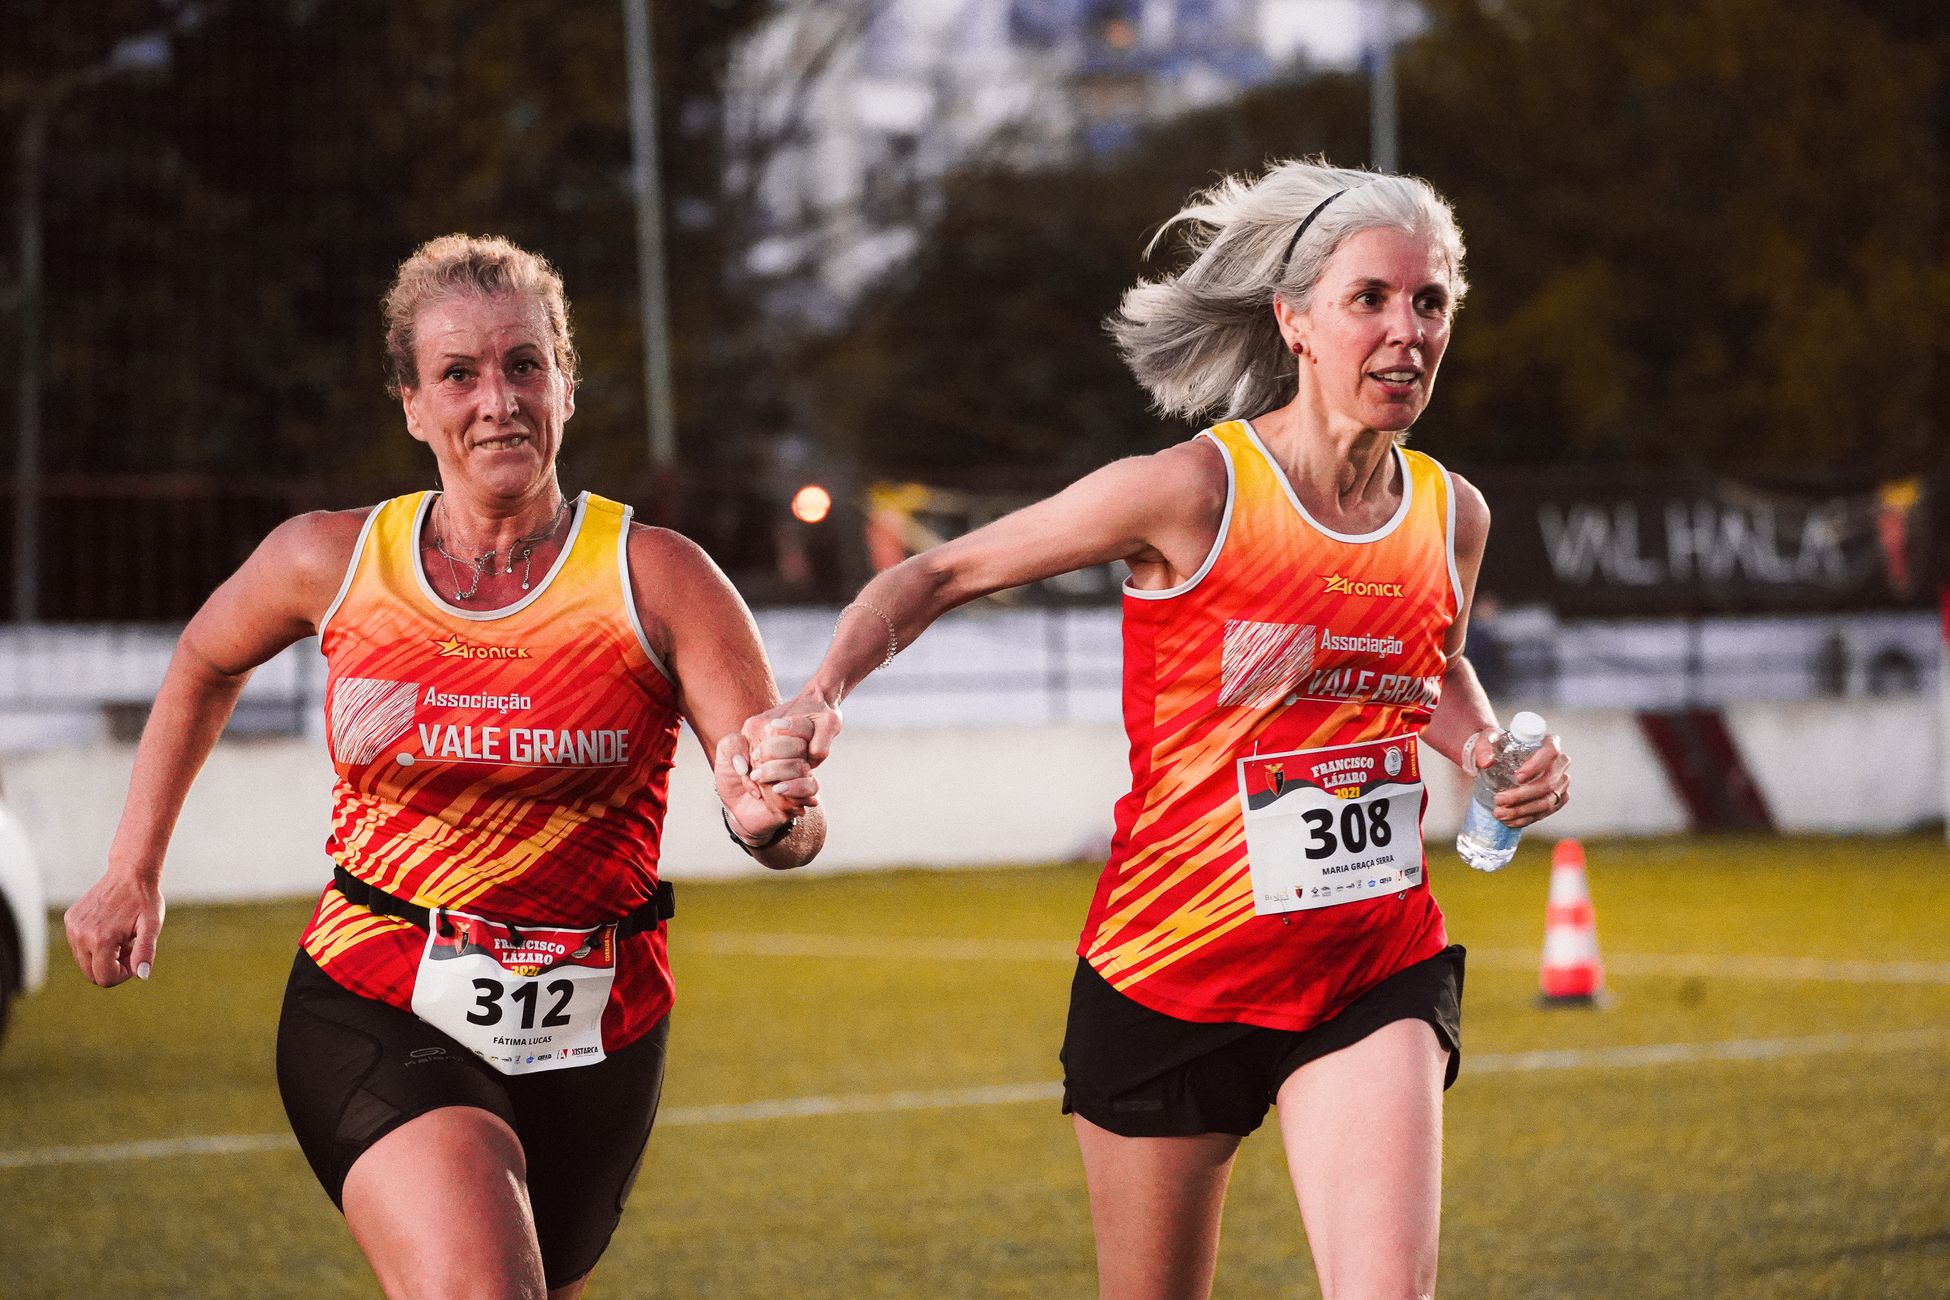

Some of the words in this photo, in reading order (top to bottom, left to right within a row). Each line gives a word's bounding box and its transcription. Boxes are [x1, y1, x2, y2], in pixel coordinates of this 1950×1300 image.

[1320, 628, 1403, 658] Associação
[1308, 668, 1375, 698] VALE
[423, 687, 531, 714] Associação
[418, 723, 501, 760] VALE
[509, 728, 629, 764] GRANDE
[1311, 757, 1374, 778] FRANCISCO
[1323, 772, 1367, 788] LÁZARO
[1334, 786, 1360, 800] 2021
[1301, 798, 1392, 860] 308
[1322, 863, 1349, 876] MARIA
[1351, 859, 1375, 870] GRAÇA
[1376, 854, 1395, 865] SERRA
[494, 938, 566, 955] FRCISCO
[502, 950, 553, 966] LÁZARO
[466, 978, 575, 1030] 312
[493, 1036, 527, 1046] FÁTIMA
[528, 1035, 552, 1045] LUCAS
